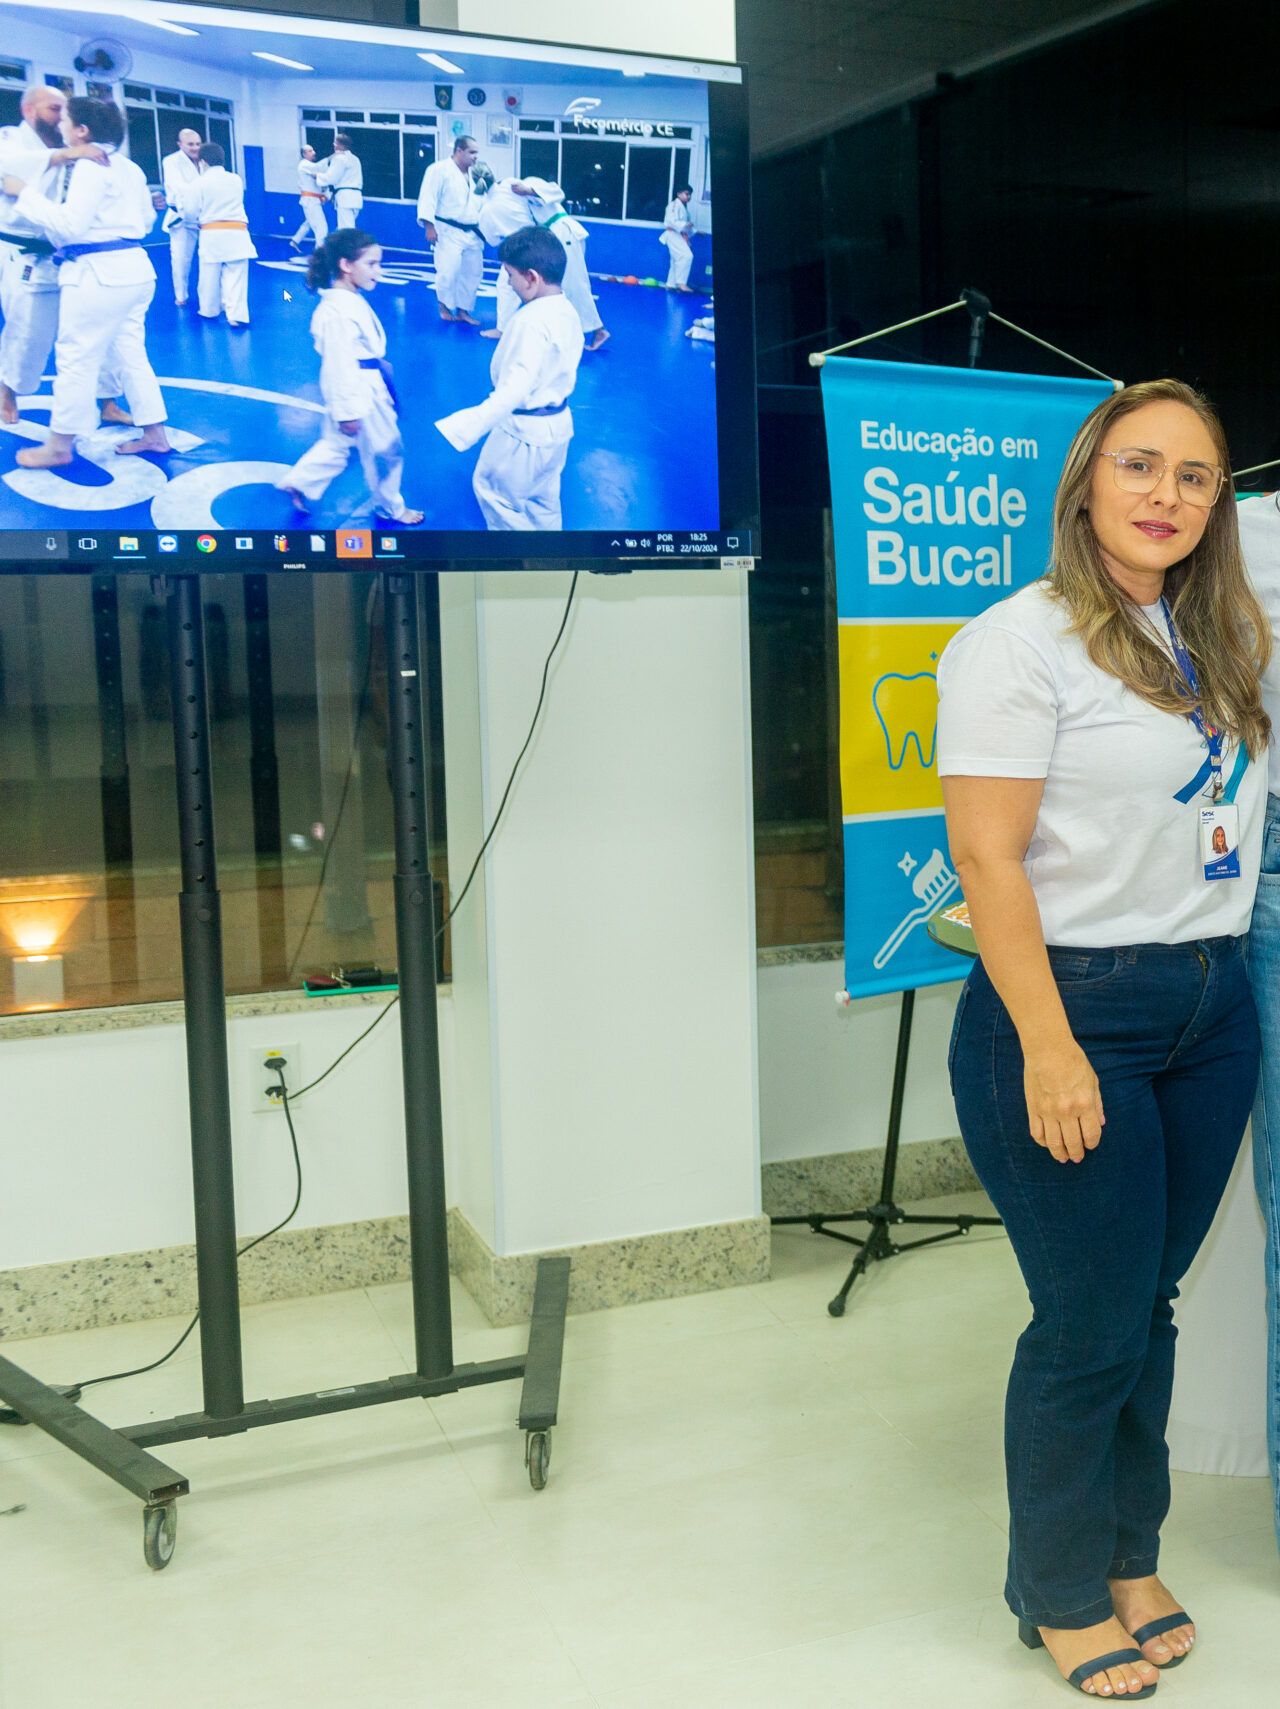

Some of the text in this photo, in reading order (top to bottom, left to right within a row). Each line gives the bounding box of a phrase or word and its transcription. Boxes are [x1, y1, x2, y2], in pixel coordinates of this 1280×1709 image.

[656, 122, 675, 137] CE
[860, 420, 1038, 462] Educação em
[862, 466, 1027, 528] Saúde
[657, 533, 708, 542] POR 18:25
[680, 545, 718, 553] 22/10/2024
[866, 530, 1012, 587] Bucal
